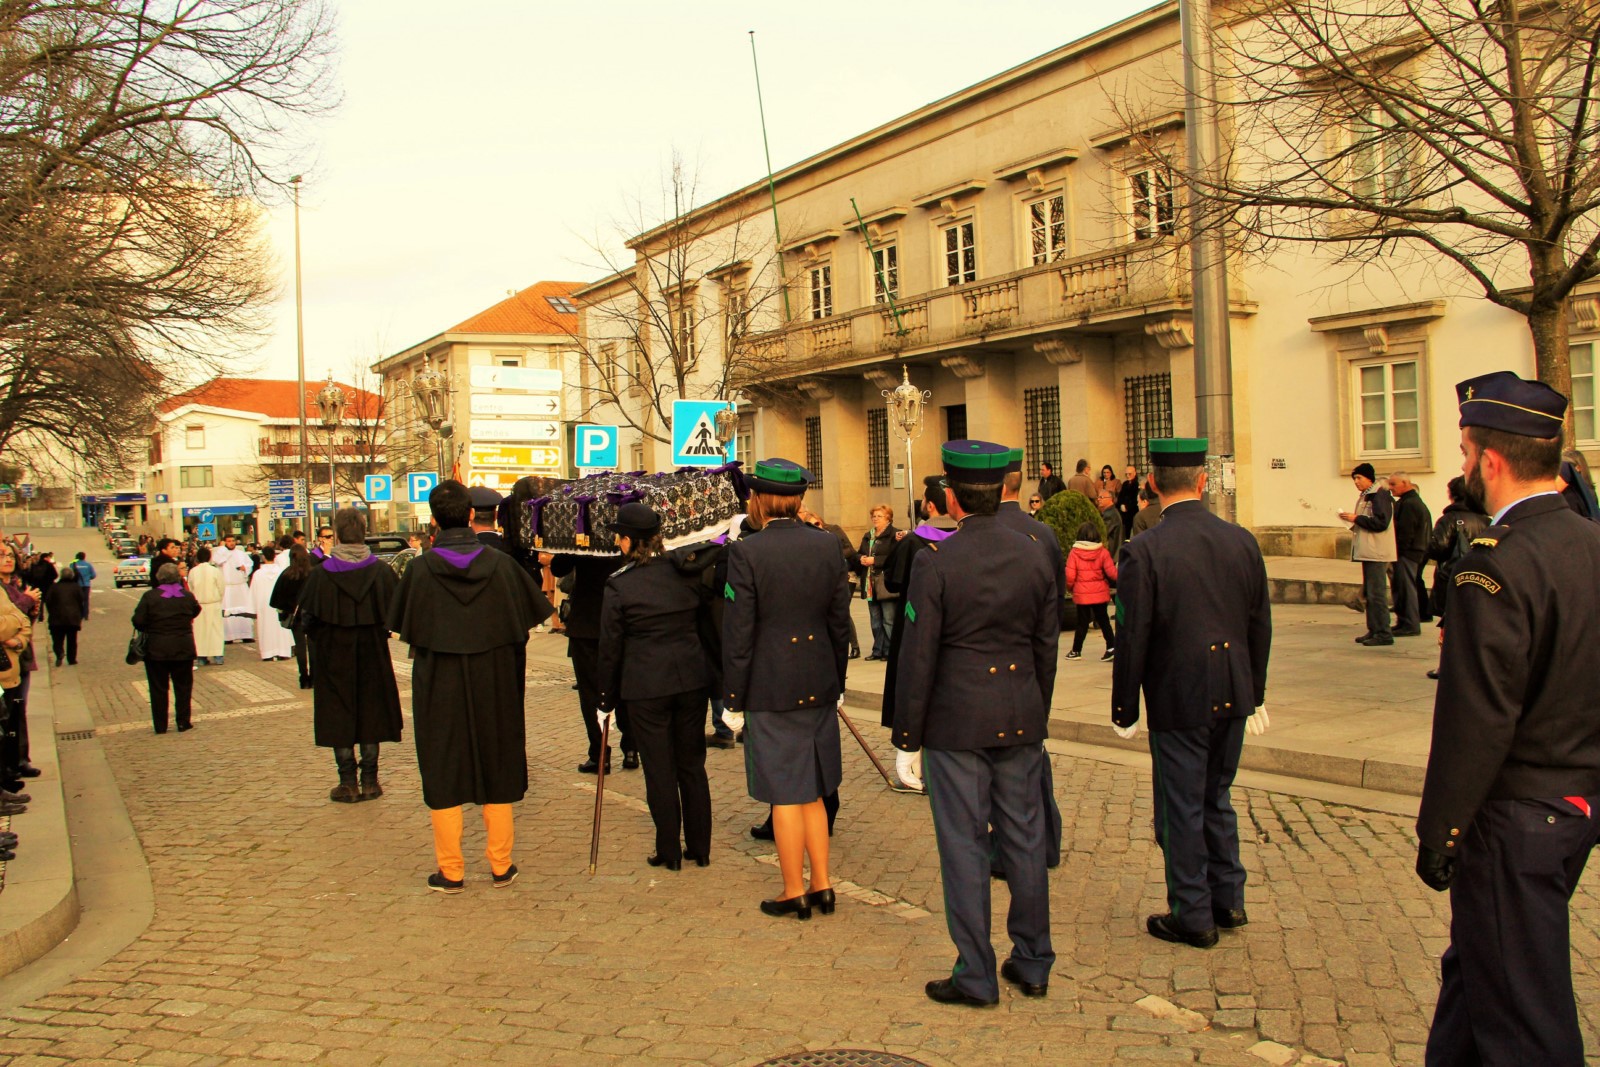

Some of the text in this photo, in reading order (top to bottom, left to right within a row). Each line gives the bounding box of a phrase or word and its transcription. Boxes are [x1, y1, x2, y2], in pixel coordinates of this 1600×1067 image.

[583, 429, 610, 464] P
[370, 477, 386, 499] P
[413, 475, 432, 500] P
[1456, 574, 1496, 591] BRAGANÇA
